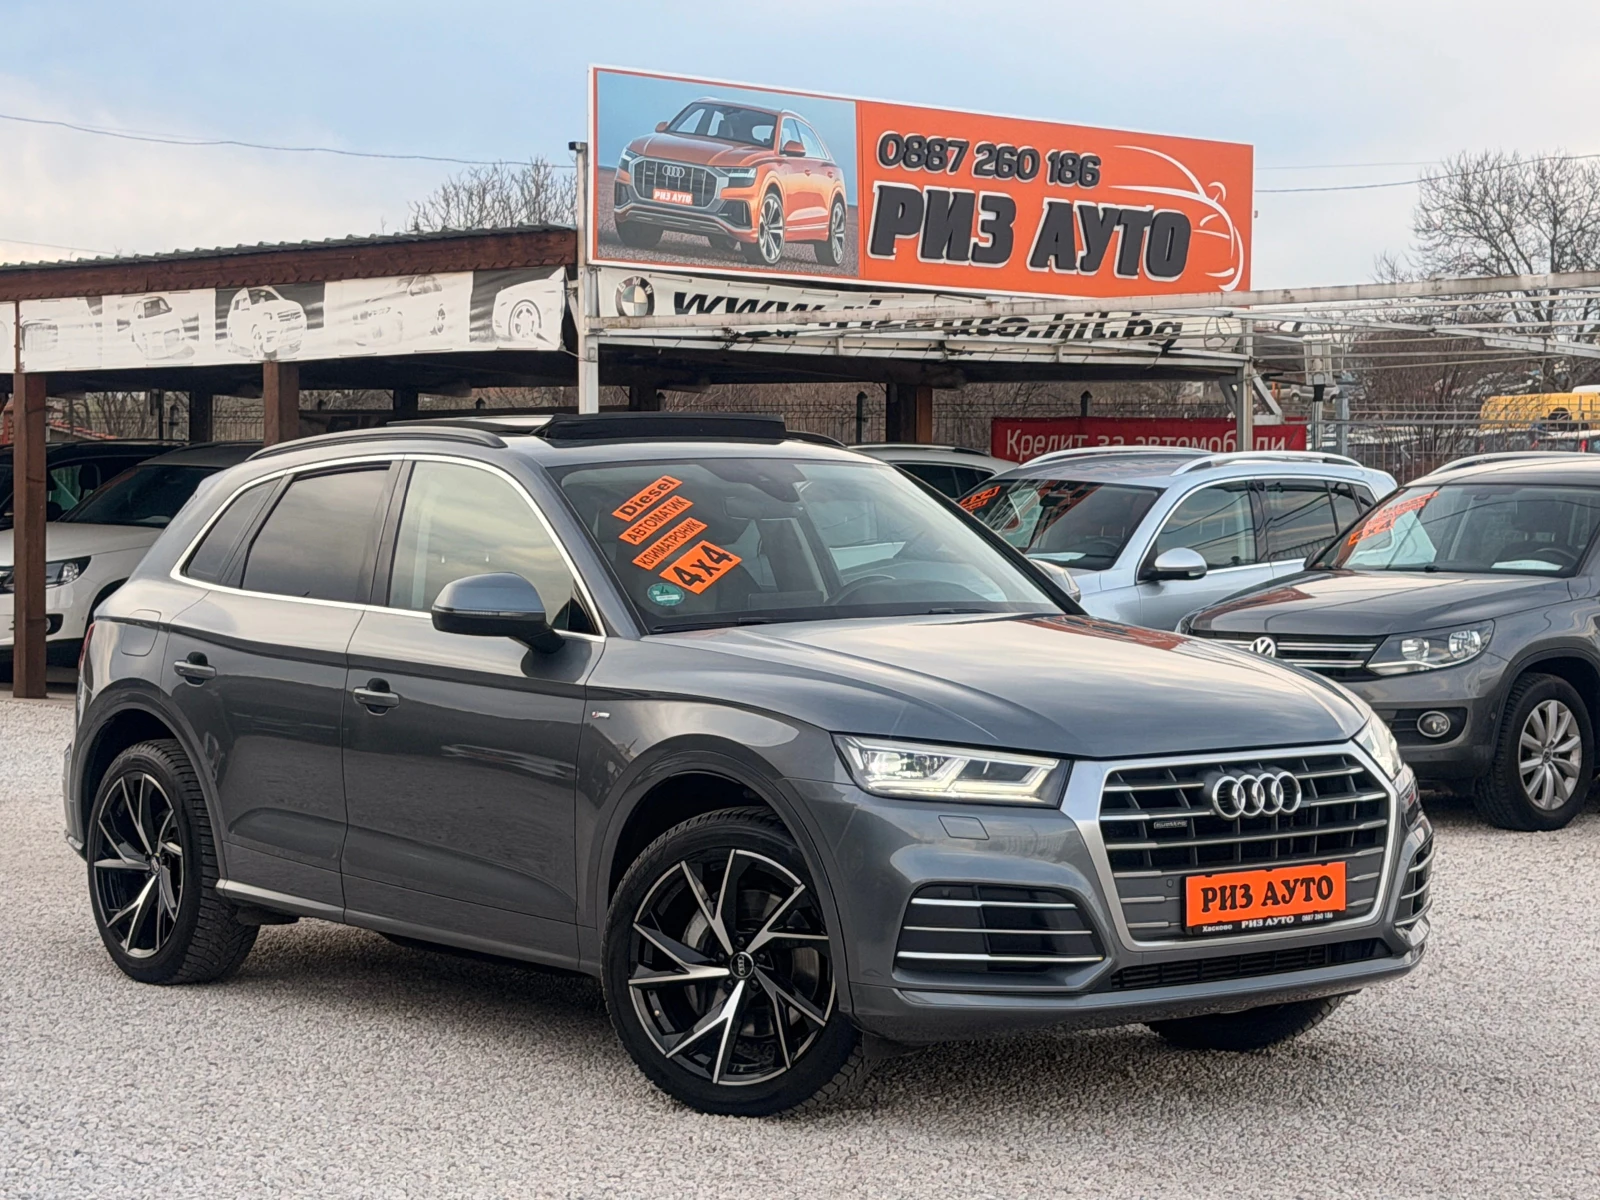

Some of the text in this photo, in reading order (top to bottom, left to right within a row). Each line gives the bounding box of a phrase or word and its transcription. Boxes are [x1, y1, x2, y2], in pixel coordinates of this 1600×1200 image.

[876, 131, 1101, 188] 0887 260 186
[654, 190, 693, 204] РИЗ АУТО
[867, 181, 1191, 281] РИЗ АУТО
[1007, 429, 1088, 460] Кредит
[1134, 429, 1286, 452] автомобли
[618, 477, 676, 517] Diesel
[626, 497, 688, 542] АВТОМАТИК
[638, 520, 701, 566] КЛИМАТРОНИК
[1201, 875, 1334, 913] РИЗ АУТО
[1241, 918, 1263, 929] РИЗ
[1264, 915, 1295, 927] АУТО
